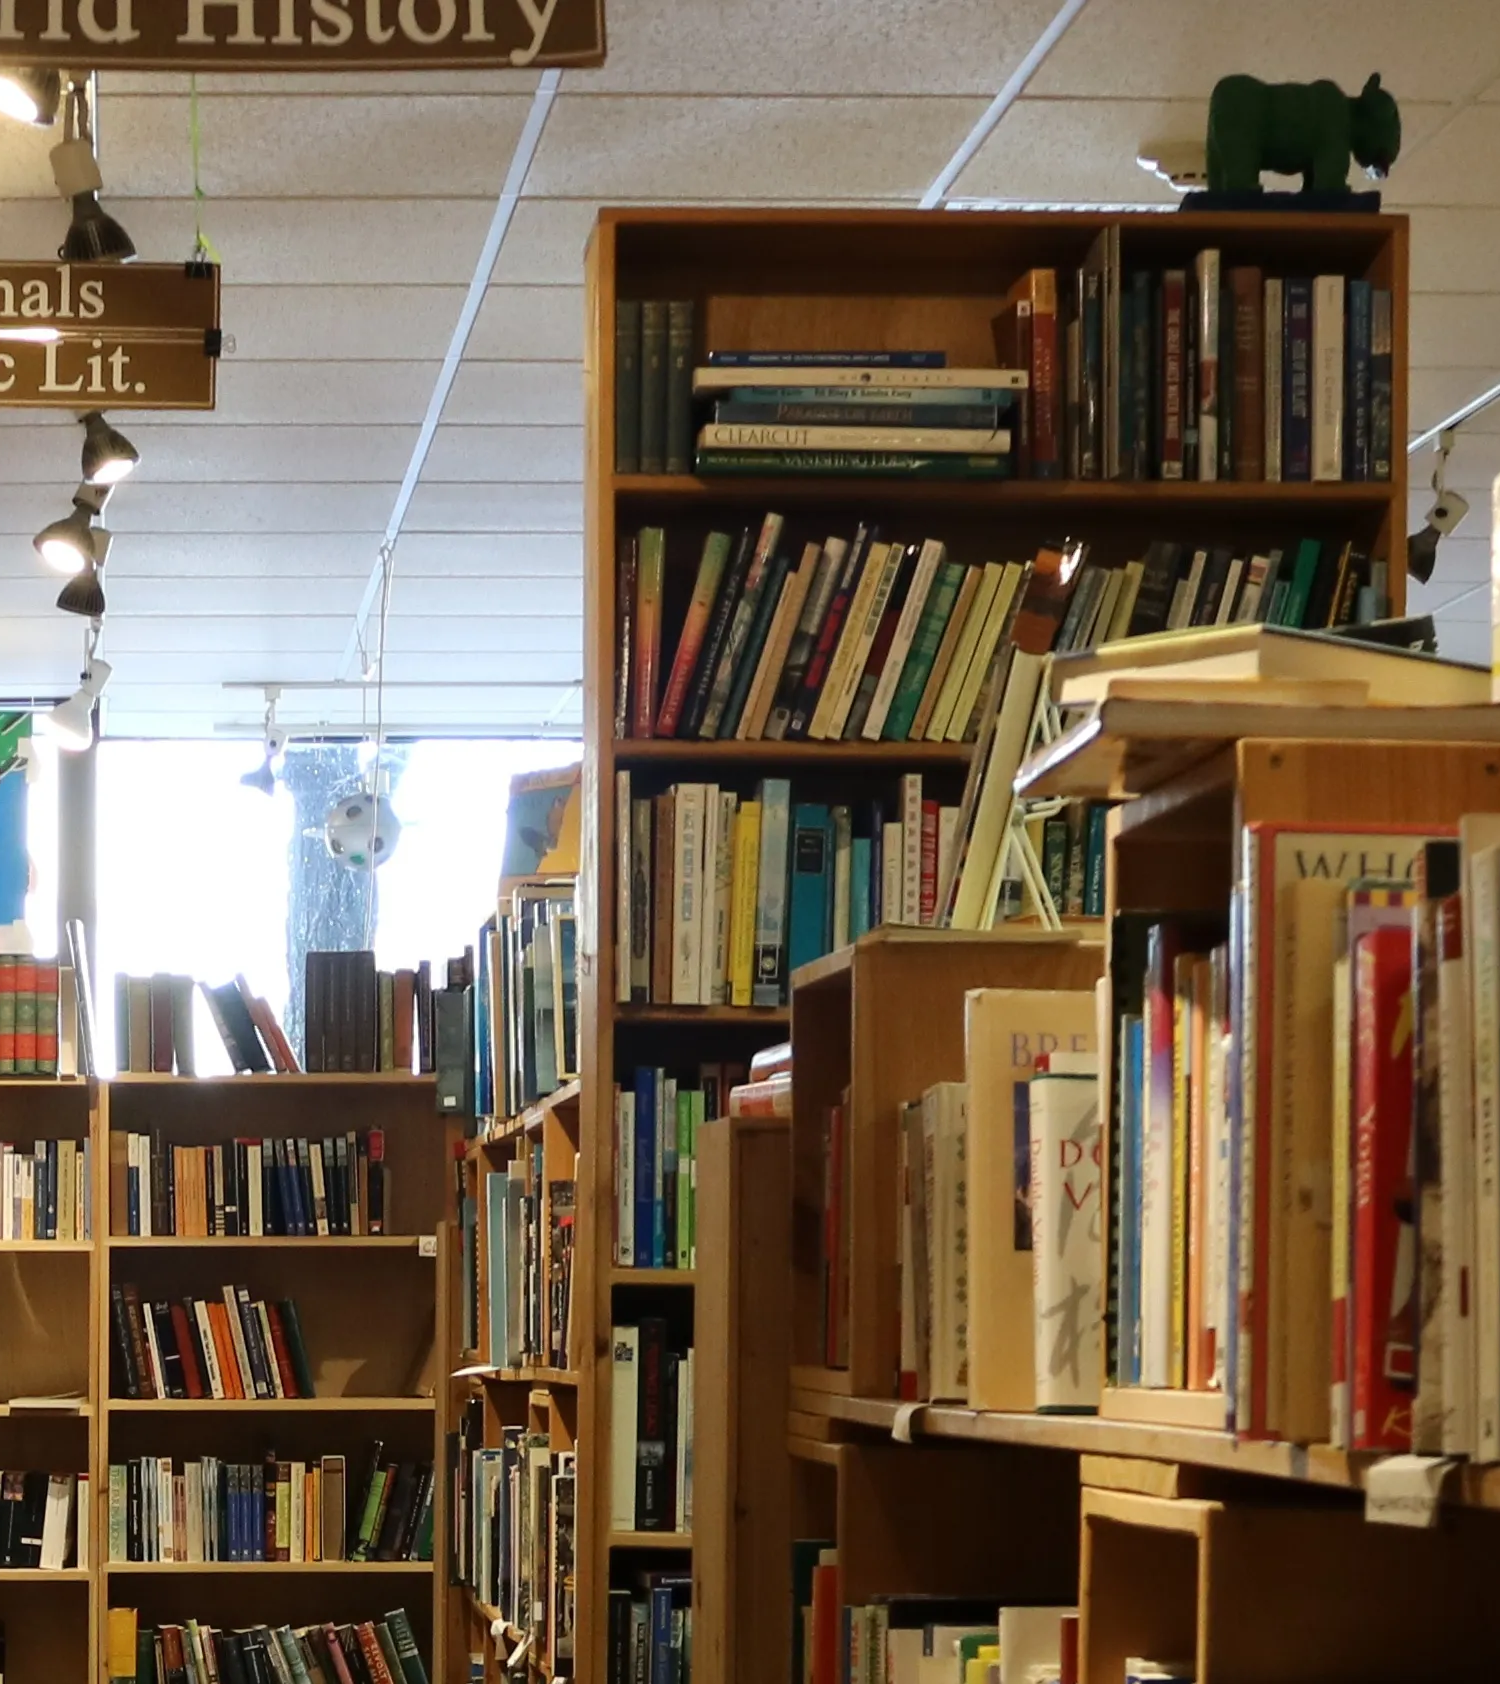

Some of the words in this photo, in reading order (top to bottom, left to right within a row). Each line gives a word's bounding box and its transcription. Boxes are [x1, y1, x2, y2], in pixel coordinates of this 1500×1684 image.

[177, 0, 556, 66] History
[38, 339, 146, 395] Lit.
[714, 428, 810, 445] CLEARCUT
[1355, 1105, 1377, 1209] Yoga
[363, 1647, 373, 1665] SAN
[369, 1643, 387, 1680] REVOLT
